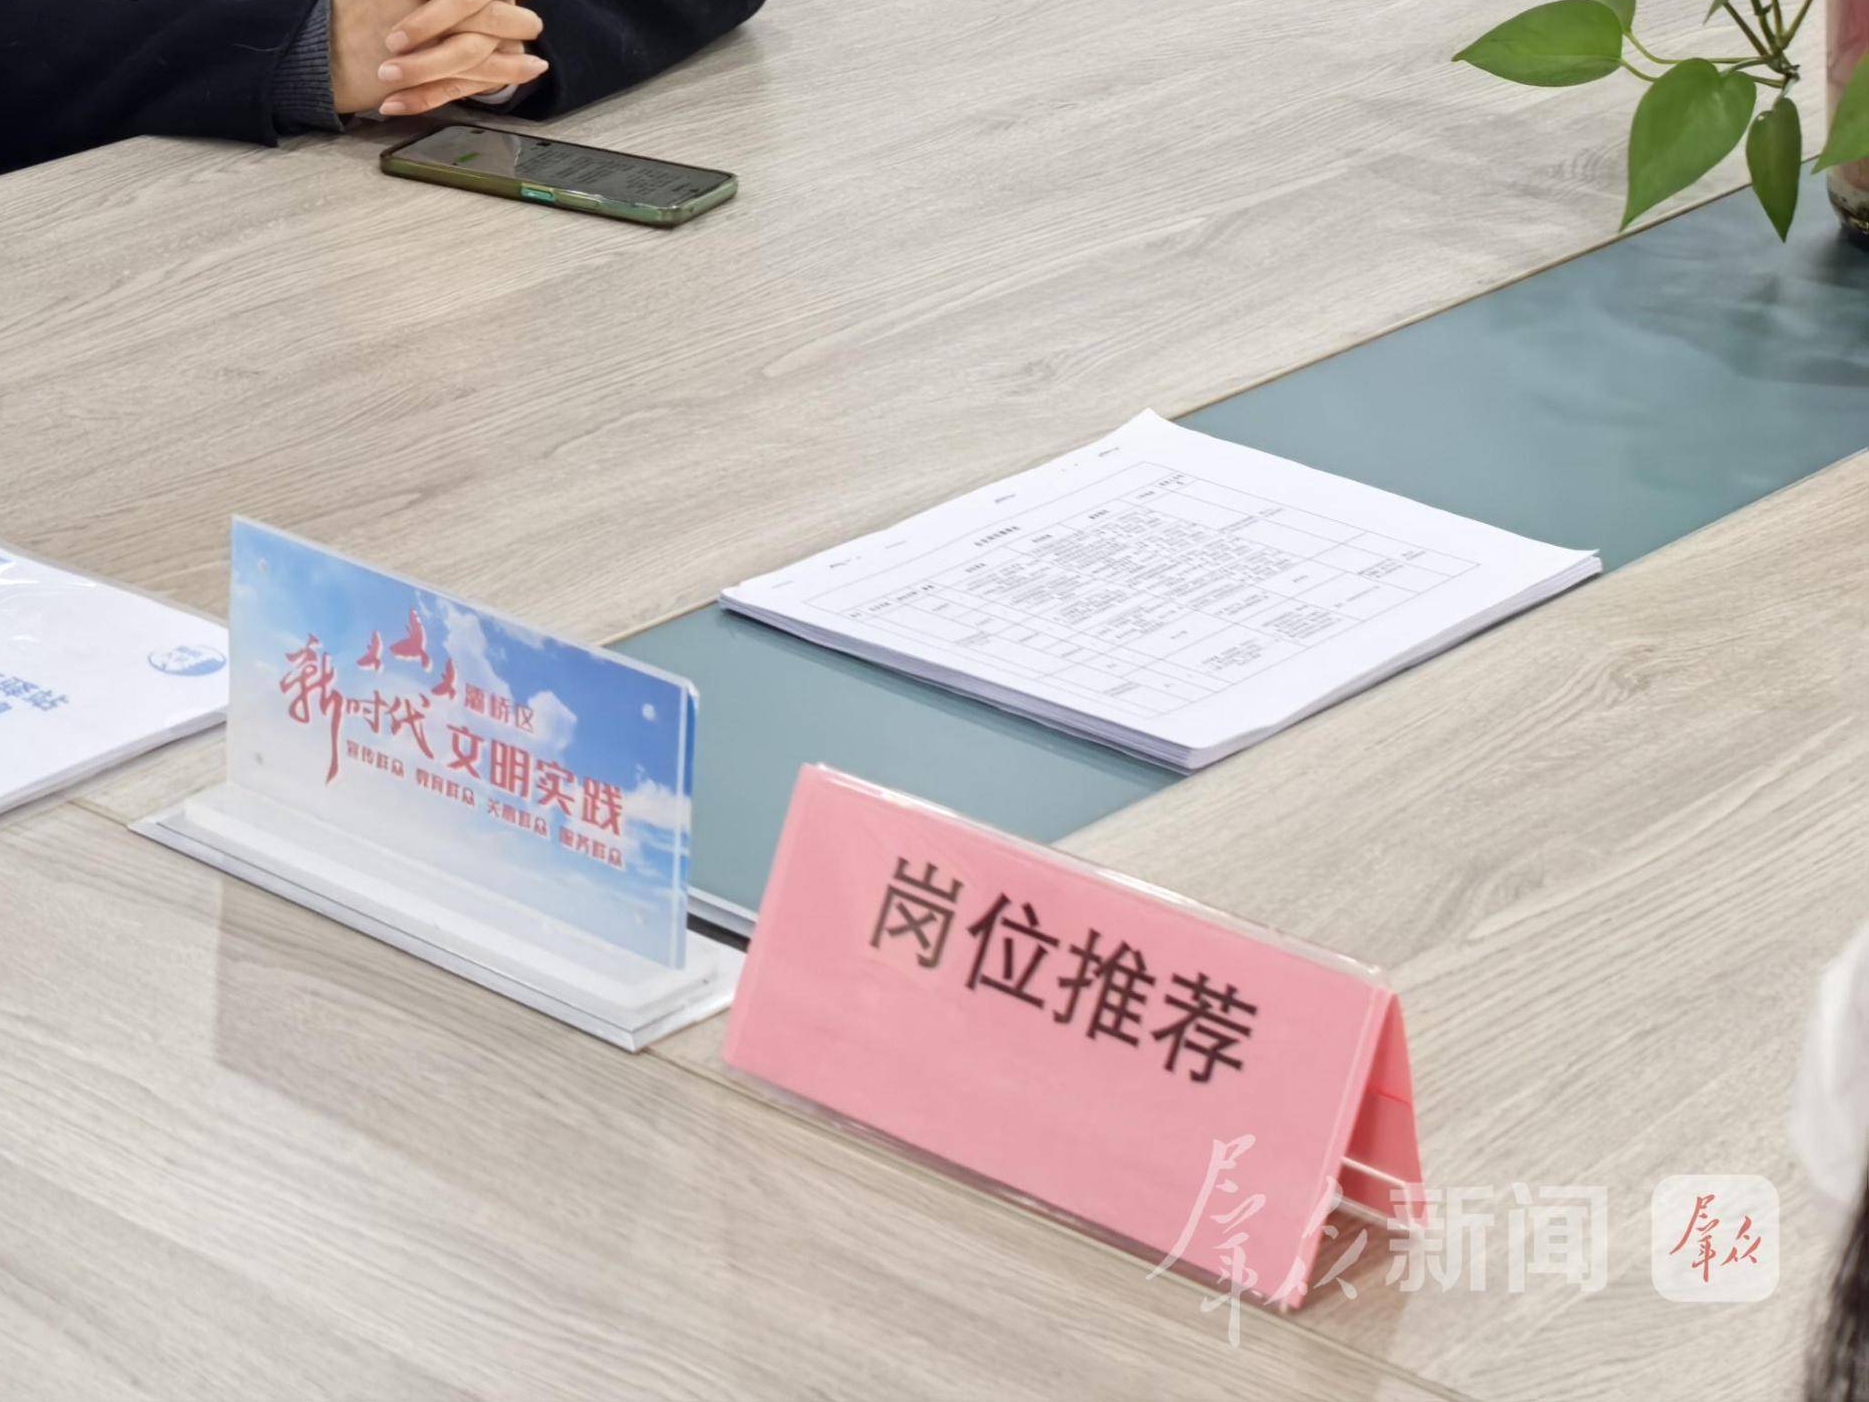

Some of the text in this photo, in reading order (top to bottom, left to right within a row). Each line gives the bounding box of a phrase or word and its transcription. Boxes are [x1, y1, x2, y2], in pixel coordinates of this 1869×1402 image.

[280, 634, 624, 836] 新时代 文明实践
[465, 682, 535, 734] 灞桥区
[346, 740, 405, 778] 宣传群众
[558, 826, 624, 868] 服务群众
[869, 856, 1258, 1086] 岗位推荐
